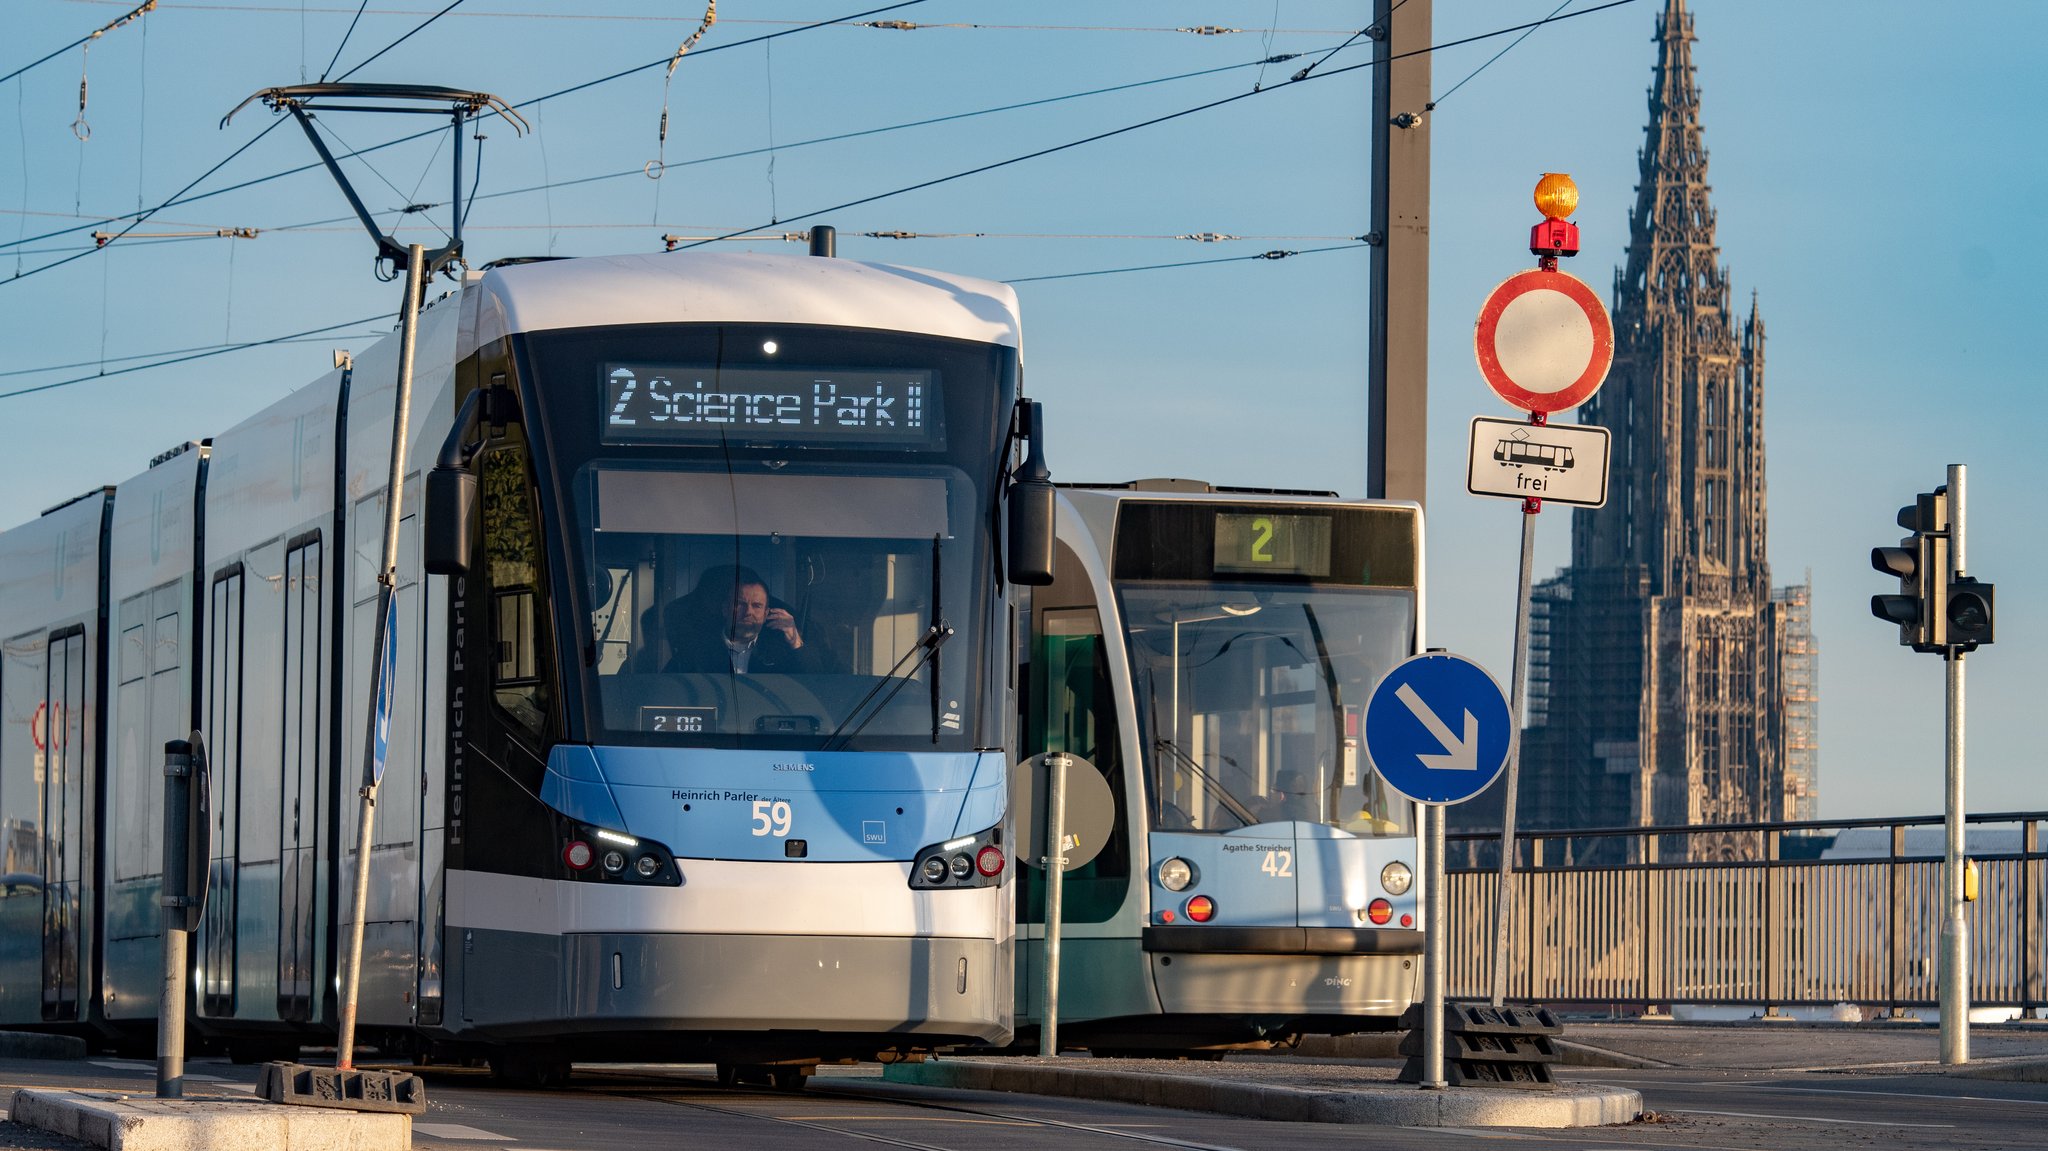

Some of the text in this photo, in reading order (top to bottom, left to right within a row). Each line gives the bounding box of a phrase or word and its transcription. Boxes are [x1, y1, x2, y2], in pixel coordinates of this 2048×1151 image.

[609, 367, 636, 425] 2
[649, 376, 801, 424] Science
[814, 379, 895, 427] Park
[1517, 473, 1548, 491] frei
[1252, 518, 1273, 561] 2
[451, 576, 465, 844] Heinrich Parle
[654, 715, 667, 732] 2
[772, 763, 815, 772] SIEMENS
[671, 790, 721, 801] Heinrich
[723, 791, 758, 802] Parler
[752, 801, 793, 837] 59
[1222, 843, 1292, 853] Agathe Streicher
[1261, 851, 1293, 877] 42
[1325, 977, 1351, 987] DING
